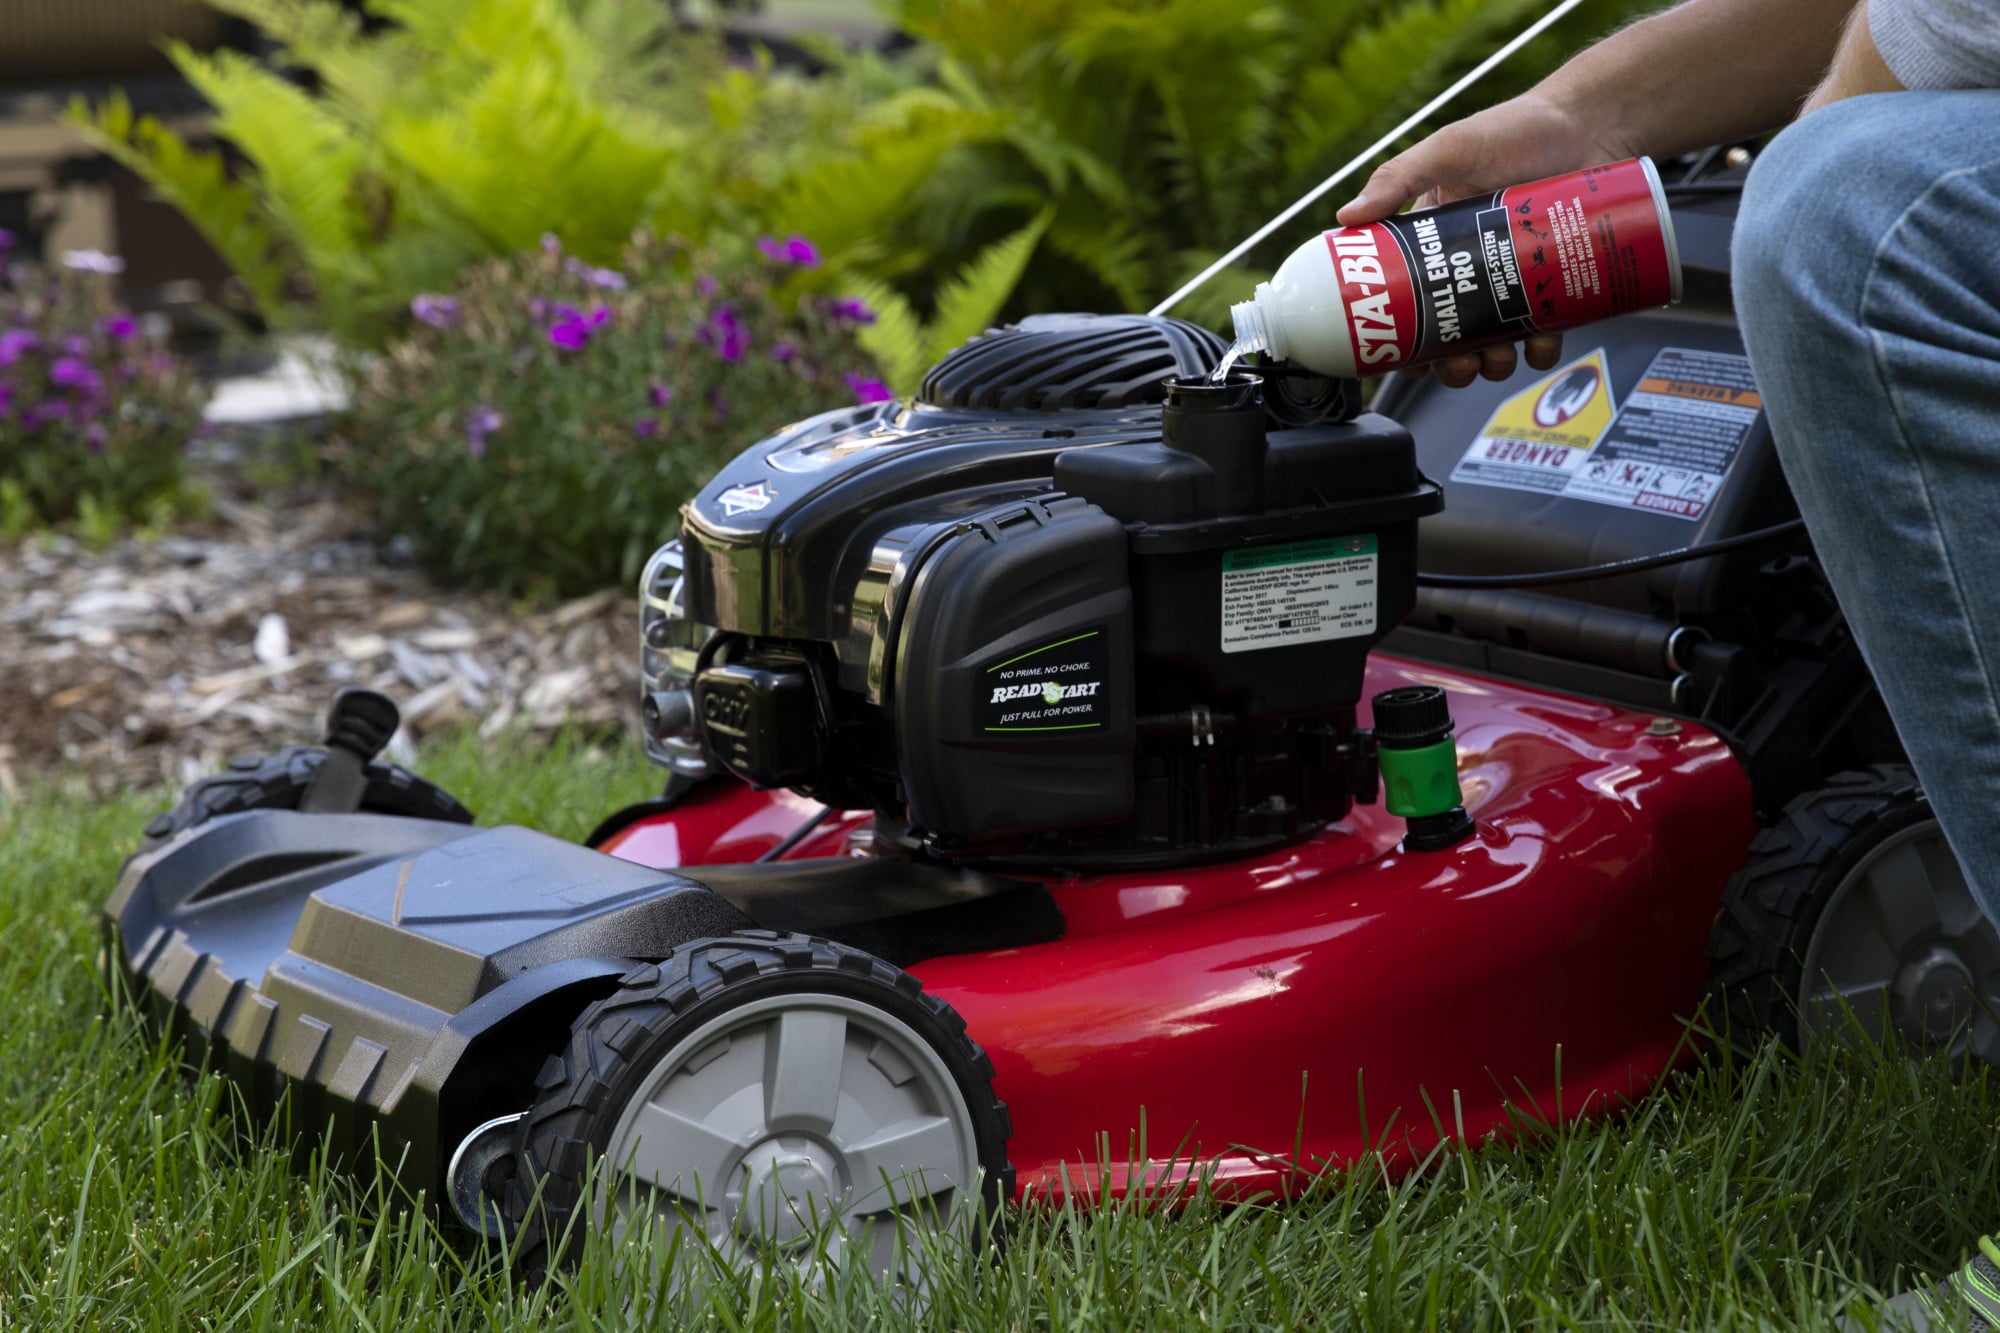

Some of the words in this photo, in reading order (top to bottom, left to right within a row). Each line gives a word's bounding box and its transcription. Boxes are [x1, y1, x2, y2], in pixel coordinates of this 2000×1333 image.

[1555, 200, 1574, 256] VALVES/PISTONS
[1566, 207, 1580, 236] ENGINES
[1572, 196, 1586, 226] ETHANOL
[1413, 216, 1450, 282] ENGINE
[1547, 206, 1568, 269] CARBS/INJECTORS
[1574, 238, 1585, 260] NOISY
[1581, 227, 1594, 258] AGAINST
[1450, 251, 1478, 294] PRO
[1484, 230, 1510, 300] MULTI-SYSTEM
[1498, 238, 1520, 286] ADDITIVE
[1570, 258, 1584, 300] LUBRICATES
[1580, 262, 1591, 288] QUIETS
[1588, 260, 1600, 295] PROTECTS
[1333, 228, 1401, 364] STA-BIL
[1563, 270, 1574, 297] CLEANS
[1432, 284, 1461, 342] SMALL
[1486, 441, 1570, 467] DANGER
[1000, 672, 1014, 680] NO
[1016, 668, 1042, 678] PRIME.
[1060, 662, 1091, 672] CHOKE.
[1000, 712, 1020, 724] JUST
[1022, 710, 1042, 720] PULL
[1044, 708, 1060, 717] FOR
[1062, 704, 1093, 715] POWER.
